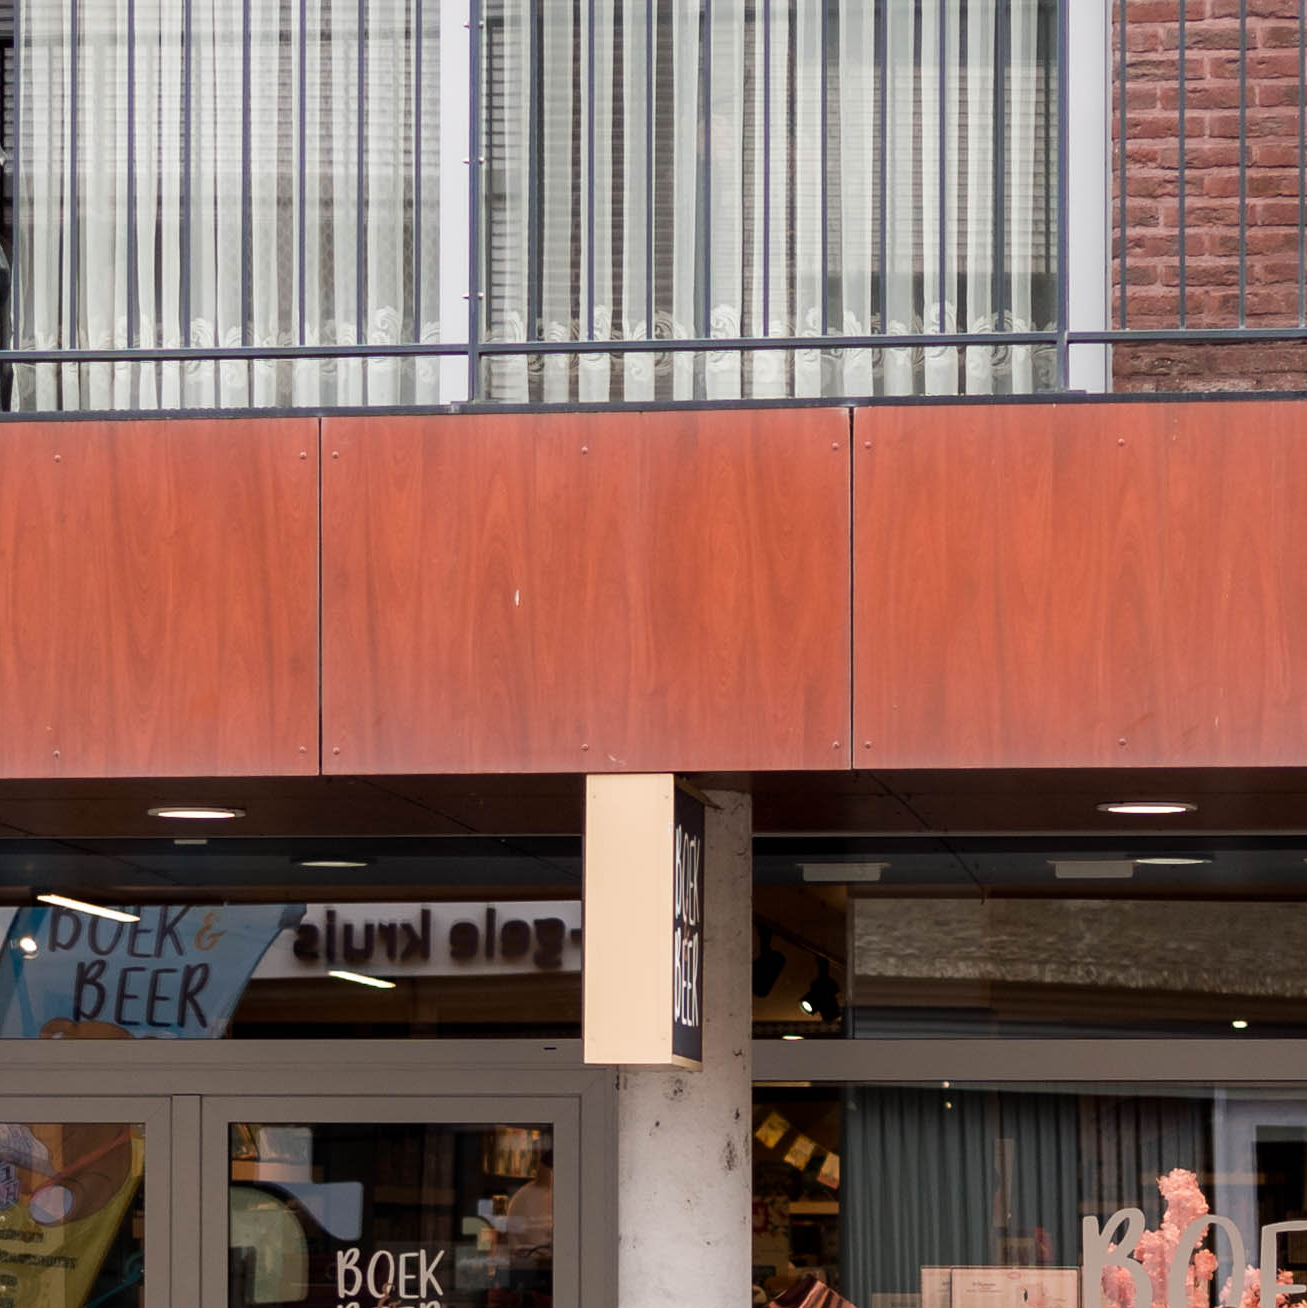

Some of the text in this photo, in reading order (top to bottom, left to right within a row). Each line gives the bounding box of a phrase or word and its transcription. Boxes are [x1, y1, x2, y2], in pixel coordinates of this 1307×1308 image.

[676, 824, 700, 925] BOEK
[73, 959, 211, 1029] BEER
[674, 926, 698, 1027] BEER
[336, 1247, 445, 1299] BOEK
